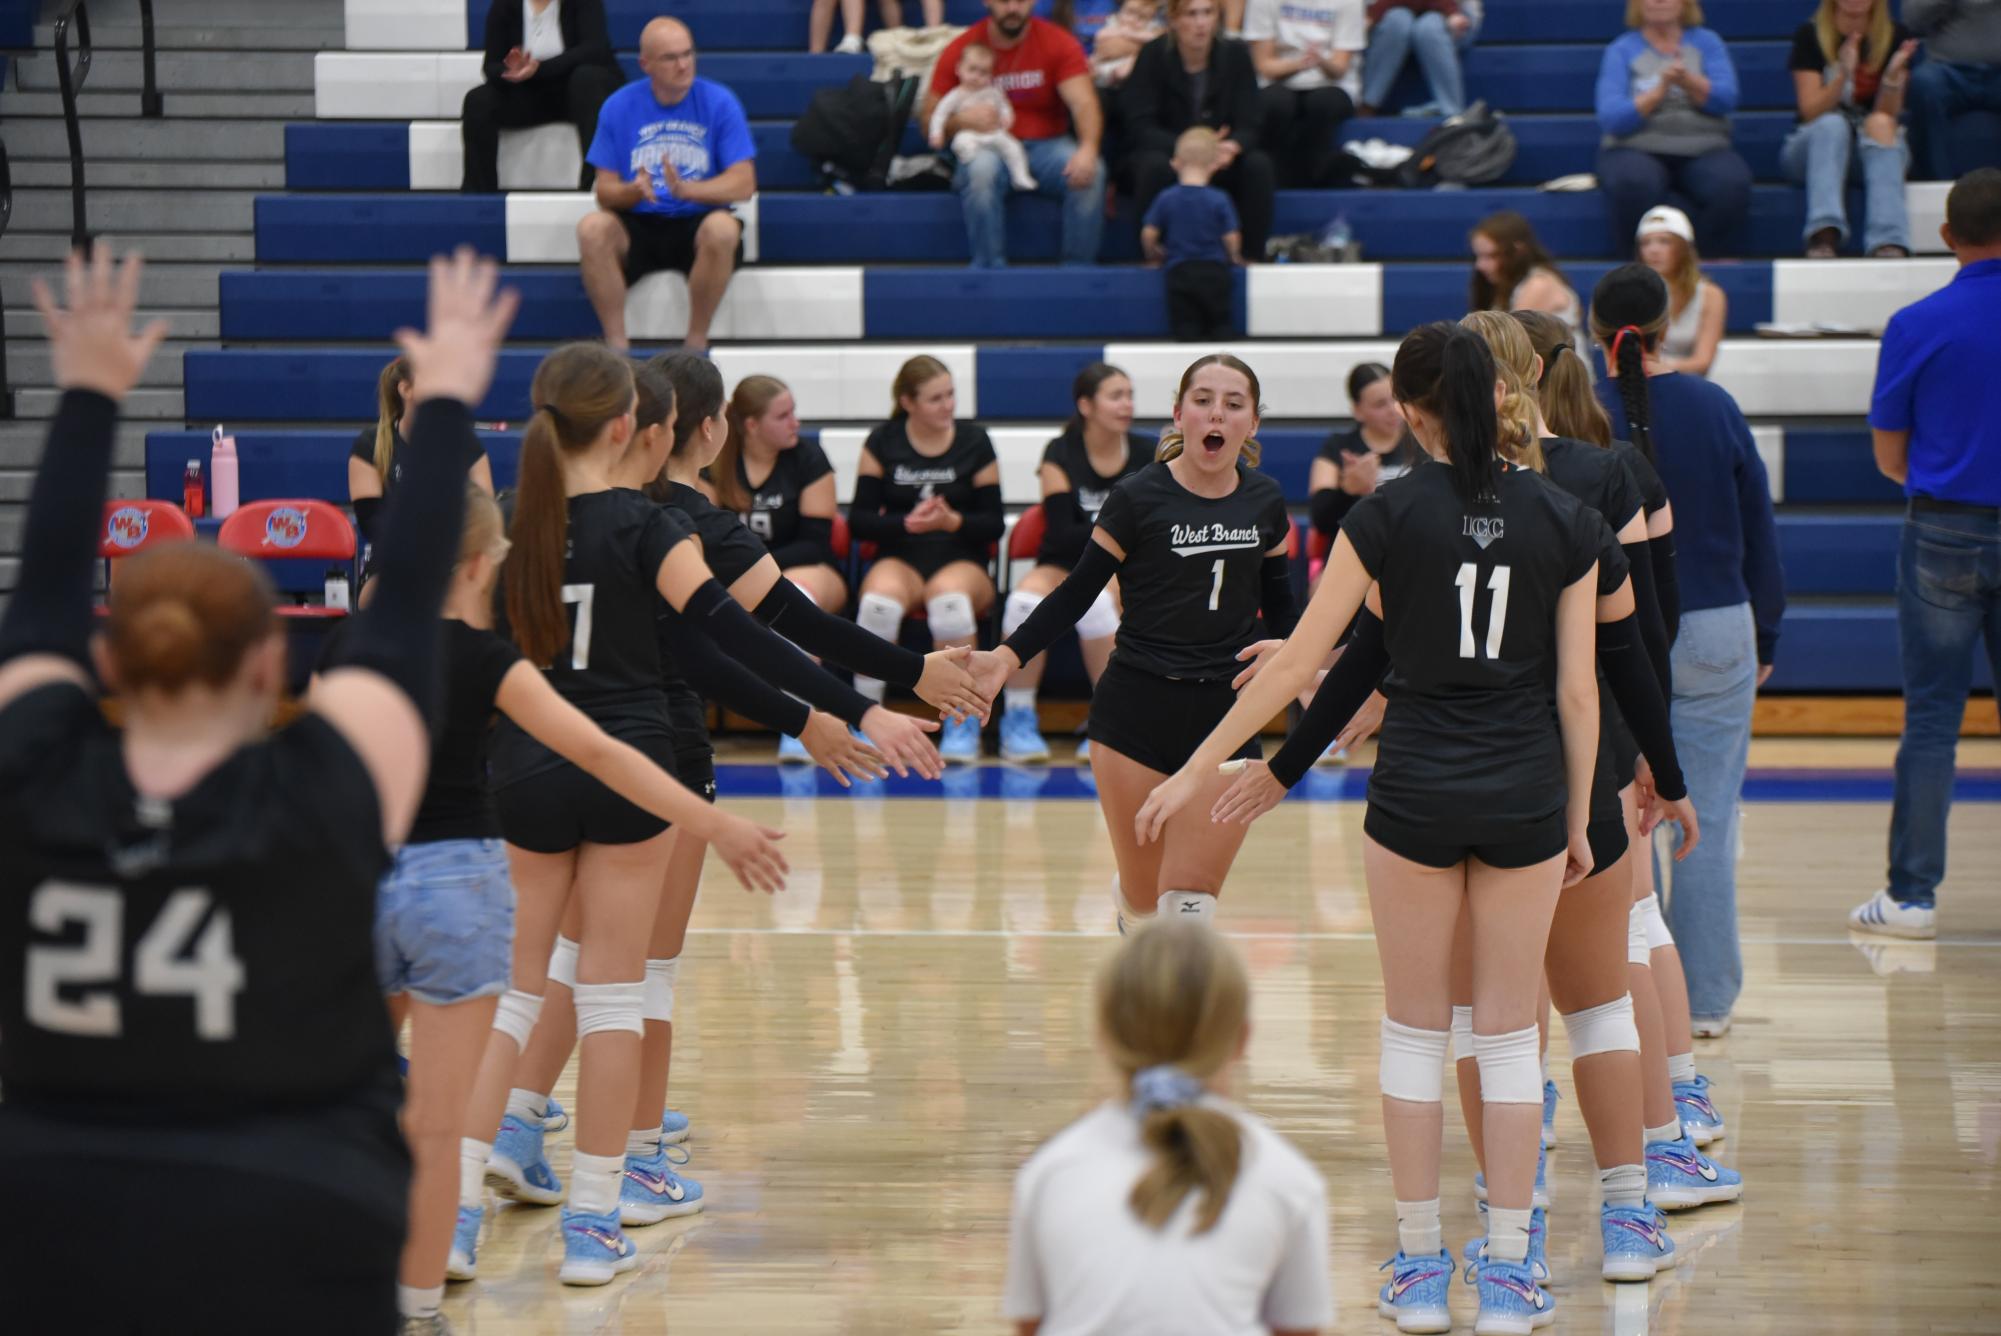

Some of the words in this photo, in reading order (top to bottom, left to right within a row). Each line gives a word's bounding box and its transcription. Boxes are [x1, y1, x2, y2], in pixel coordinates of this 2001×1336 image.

[1170, 524, 1209, 545] West
[1211, 523, 1260, 544] Branch
[1208, 559, 1225, 611] 1
[1454, 562, 1511, 659] 11
[25, 878, 247, 1041] 24
